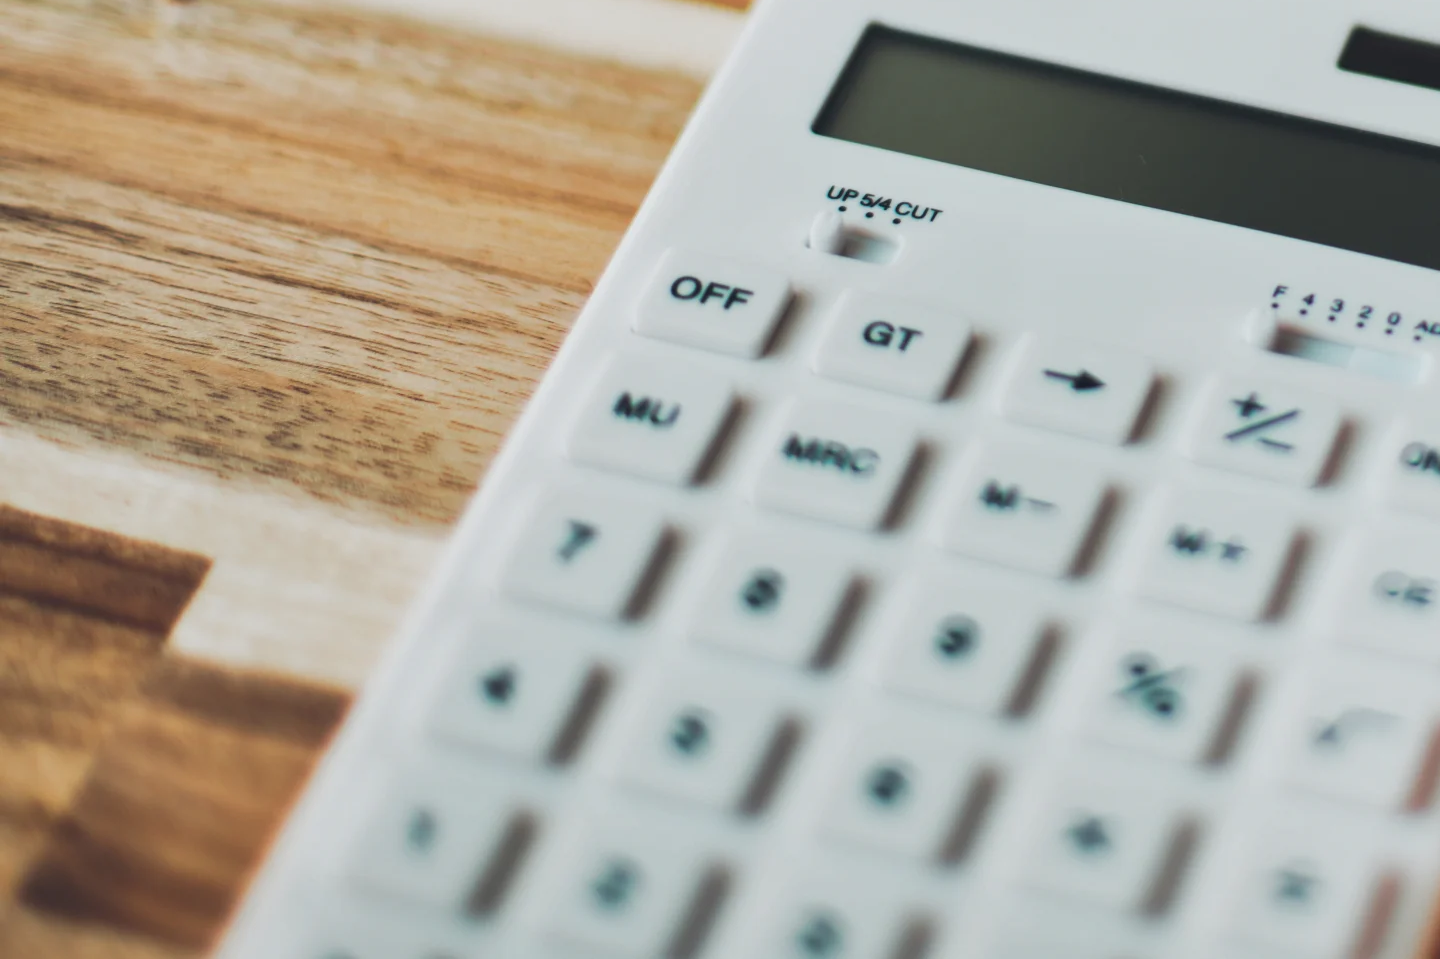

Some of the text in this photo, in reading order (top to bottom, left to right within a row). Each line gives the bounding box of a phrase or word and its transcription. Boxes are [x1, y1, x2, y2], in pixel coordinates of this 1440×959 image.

[826, 185, 944, 223] UP 5/4 CUT
[670, 275, 754, 310] OFF
[1272, 284, 1289, 298] F
[1302, 293, 1316, 306] 4
[1330, 298, 1345, 313] 3
[1358, 305, 1373, 320] 2
[1387, 312, 1401, 326] 0
[862, 321, 924, 352] GT
[613, 391, 682, 428] MU
[782, 433, 881, 477] MRC
